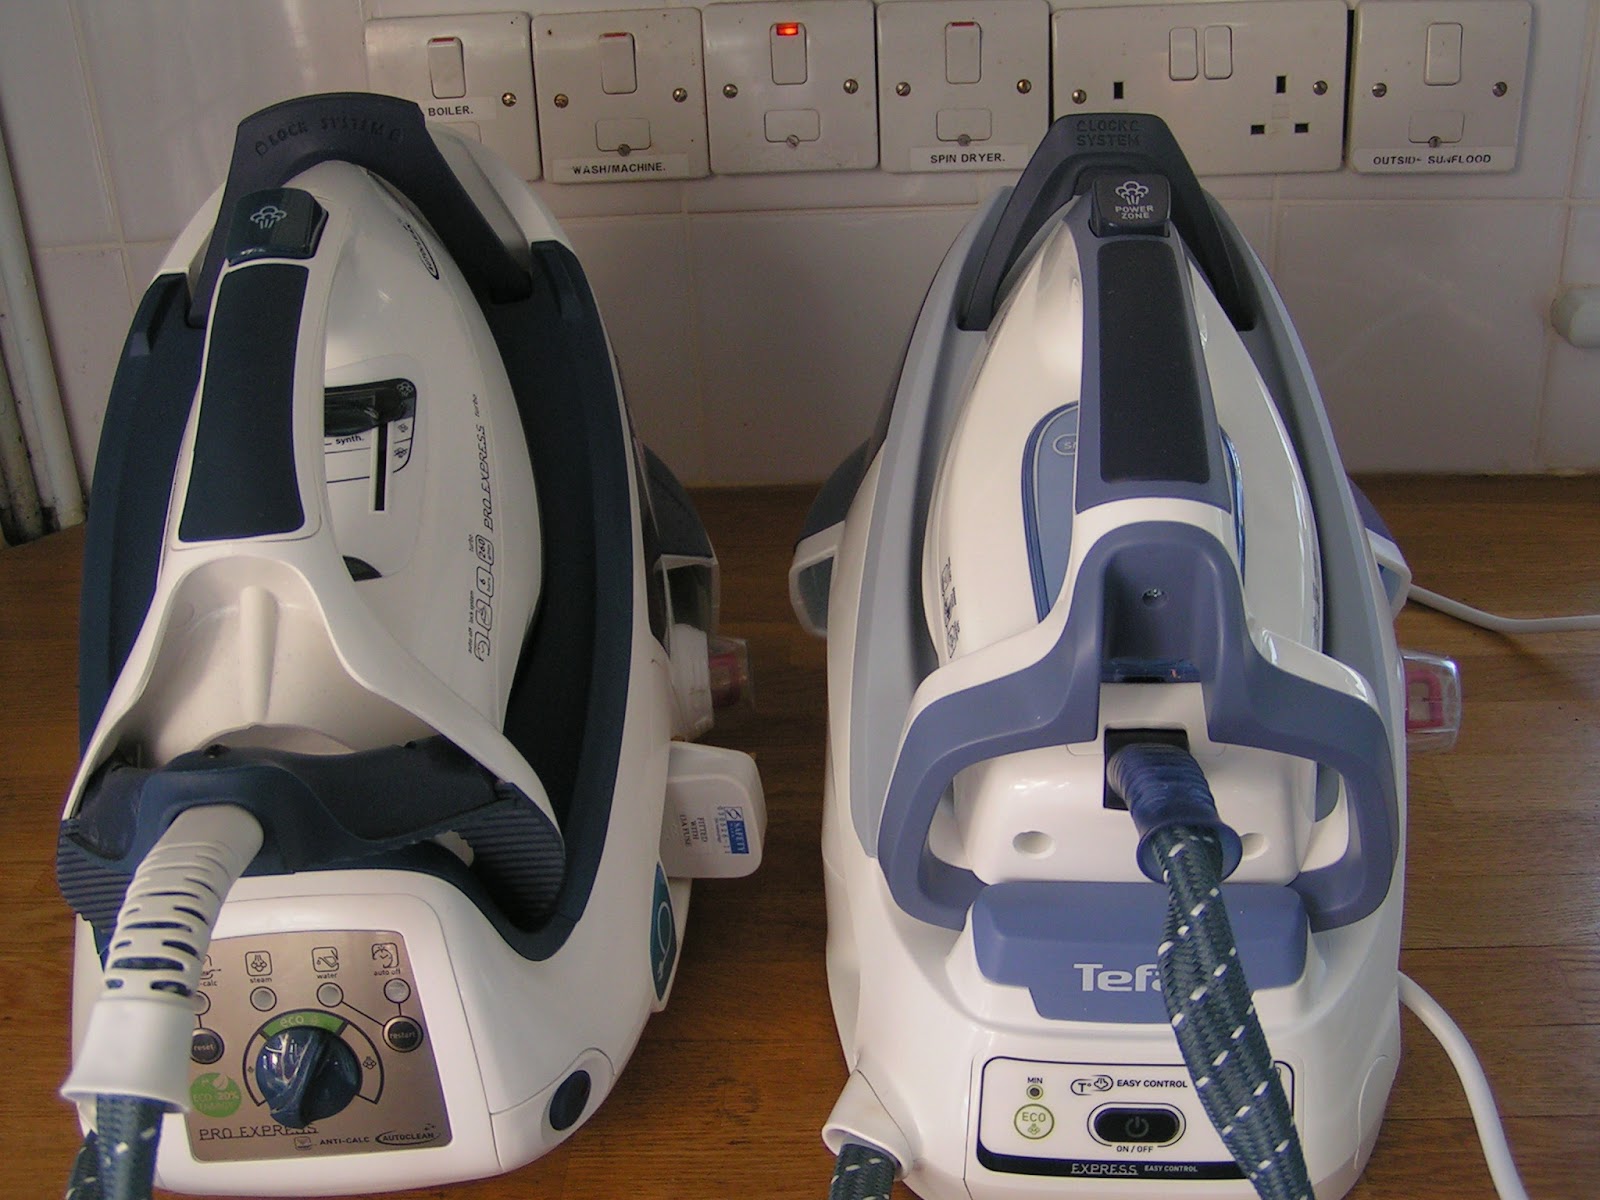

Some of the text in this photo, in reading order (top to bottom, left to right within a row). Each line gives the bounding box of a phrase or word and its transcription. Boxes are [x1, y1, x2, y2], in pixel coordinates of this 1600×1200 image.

[428, 105, 474, 117] BOILER.
[1077, 133, 1140, 146] SYSTEM
[930, 153, 1006, 164] SPIN DRYER.
[572, 162, 666, 175] WASH/MACHINE.
[1115, 205, 1154, 213] POWER
[1121, 212, 1150, 220] ZONE
[476, 424, 490, 497] EXPRESS
[482, 498, 493, 533] PRO
[478, 538, 486, 559] 260
[280, 1015, 304, 1028] eco
[390, 1031, 417, 1040] restart
[193, 1043, 215, 1051] reset
[1117, 1079, 1141, 1087] EASY
[1143, 1079, 1188, 1088] CONTROL
[1021, 1111, 1047, 1122] ECO
[199, 1127, 233, 1140] PRO
[320, 1132, 435, 1146] ANTI-CALC AUTOCLEAN
[1116, 1145, 1129, 1153] ON
[1137, 1145, 1154, 1153] OFF
[1071, 1163, 1139, 1176] EXPRESS
[1144, 1164, 1163, 1172] EASY
